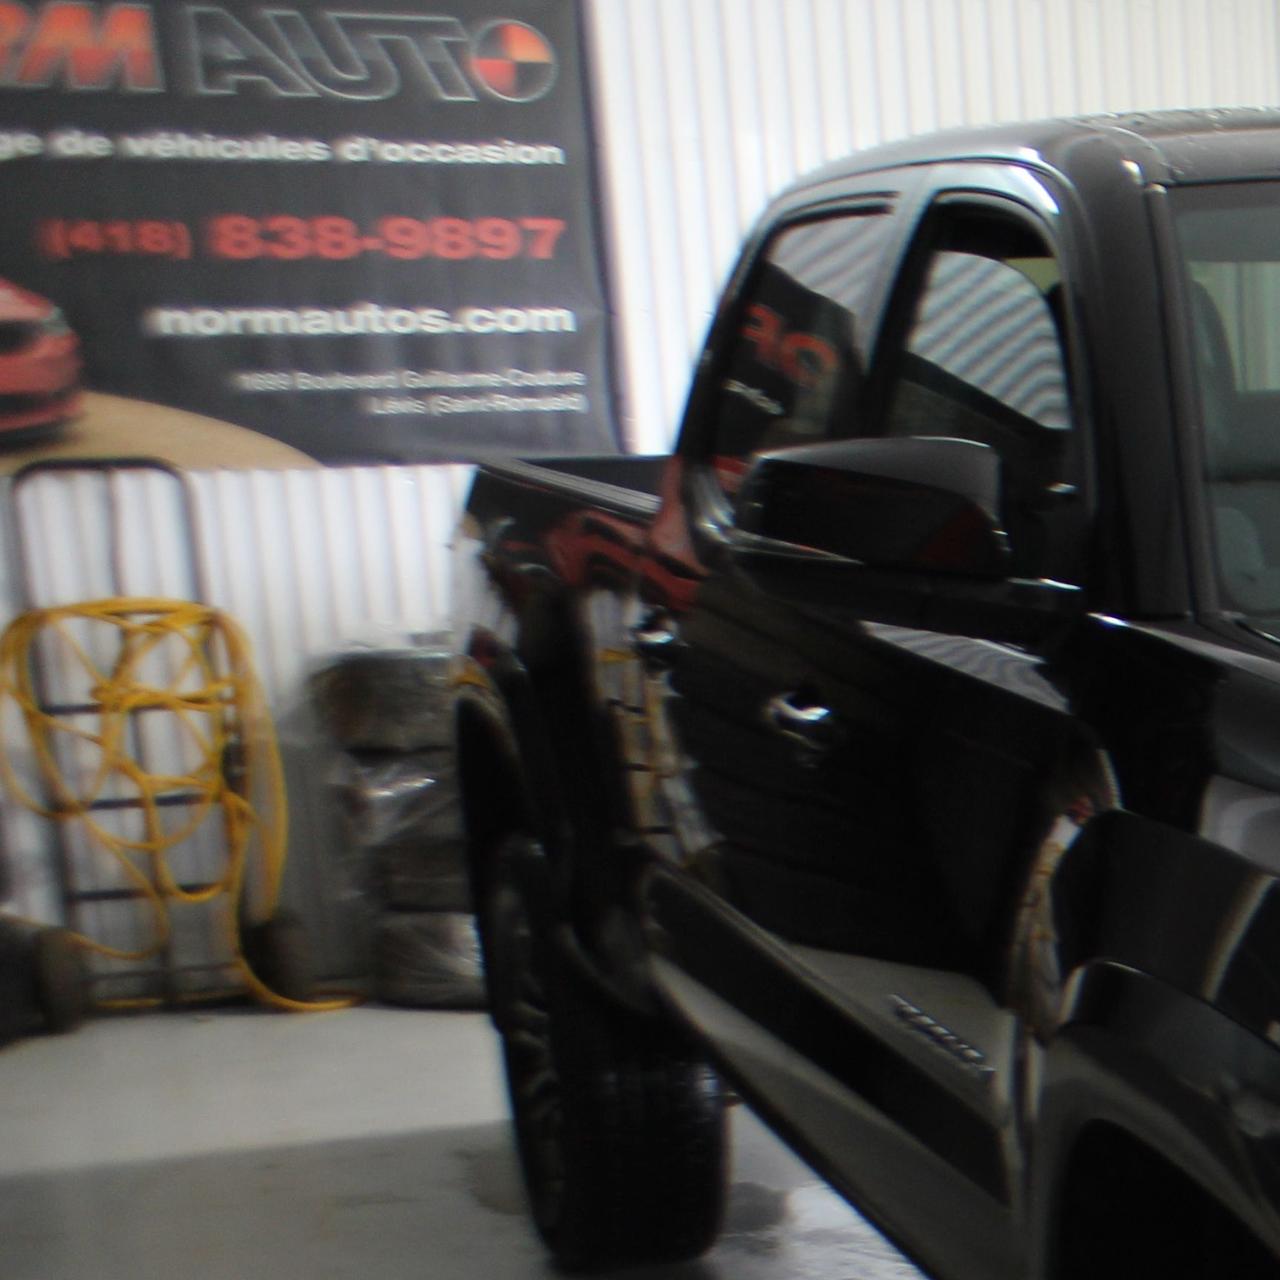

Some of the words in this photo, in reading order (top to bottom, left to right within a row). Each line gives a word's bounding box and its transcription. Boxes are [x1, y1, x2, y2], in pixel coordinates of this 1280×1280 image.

[48, 131, 113, 158] de
[122, 132, 332, 163] véhicules
[337, 137, 566, 165] d'occasion
[207, 214, 567, 260] 838-9897
[152, 305, 577, 335] normautos.com
